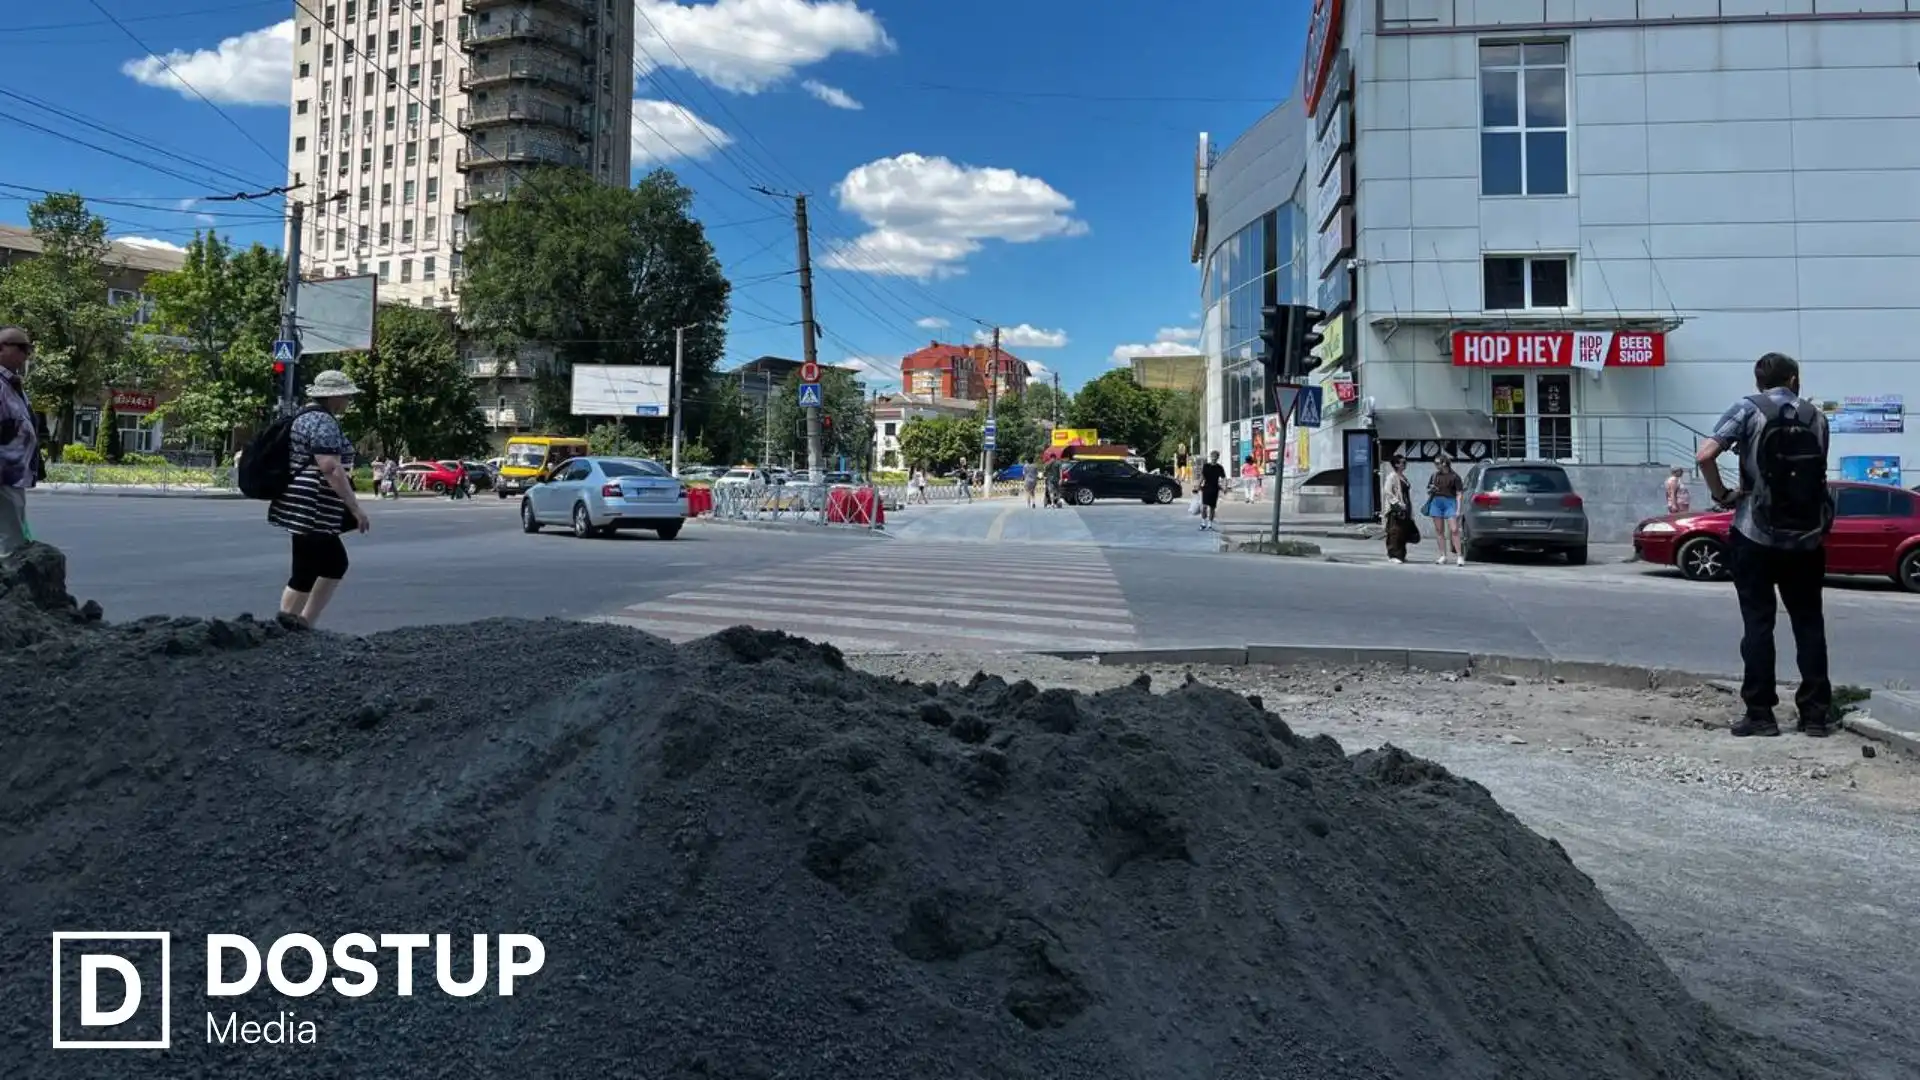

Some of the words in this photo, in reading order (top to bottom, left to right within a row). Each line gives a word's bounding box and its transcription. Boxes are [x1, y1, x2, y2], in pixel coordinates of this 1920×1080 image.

[1579, 336, 1603, 349] HOP
[1619, 336, 1653, 350] BEER
[1464, 336, 1511, 363] HOP
[1517, 336, 1563, 363] HEY
[1579, 349, 1602, 362] HEY
[1619, 350, 1653, 363] SHOP
